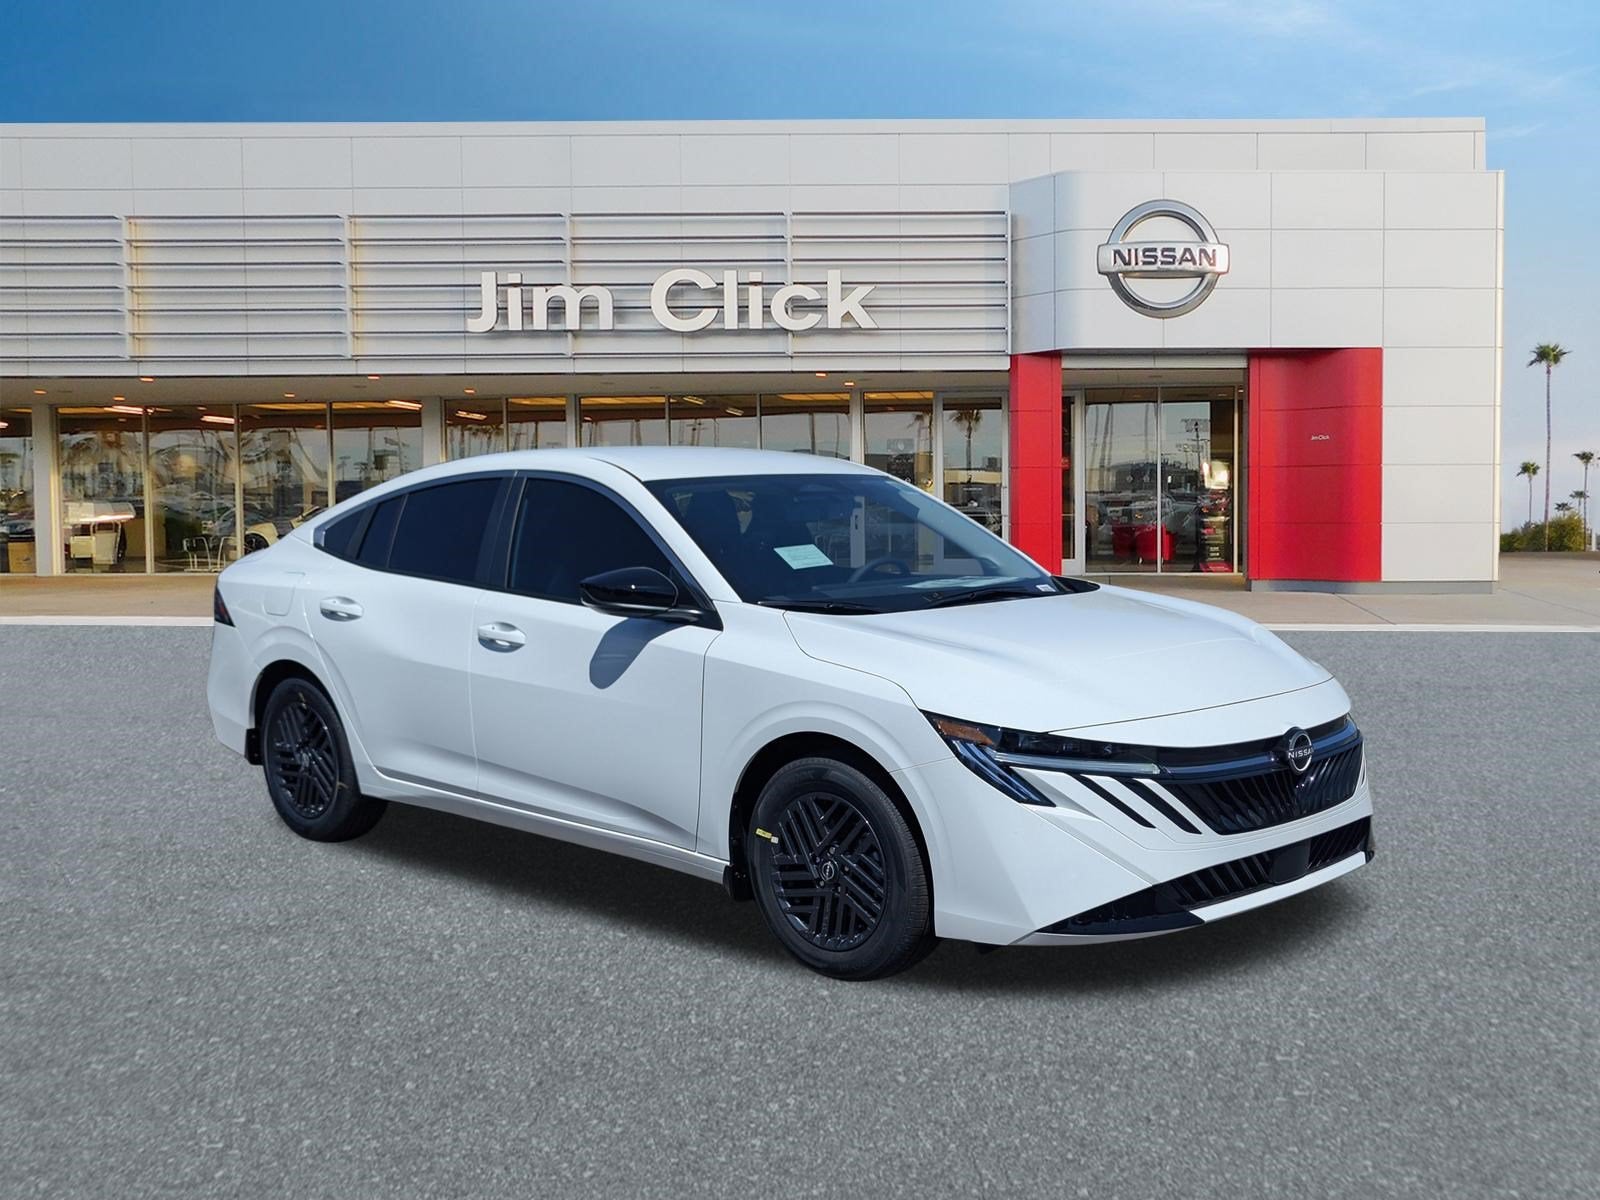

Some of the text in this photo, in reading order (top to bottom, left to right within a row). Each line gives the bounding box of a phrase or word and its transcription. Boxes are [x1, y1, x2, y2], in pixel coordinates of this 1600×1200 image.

[1112, 247, 1217, 267] NISSAN
[466, 268, 879, 333] Jim Click
